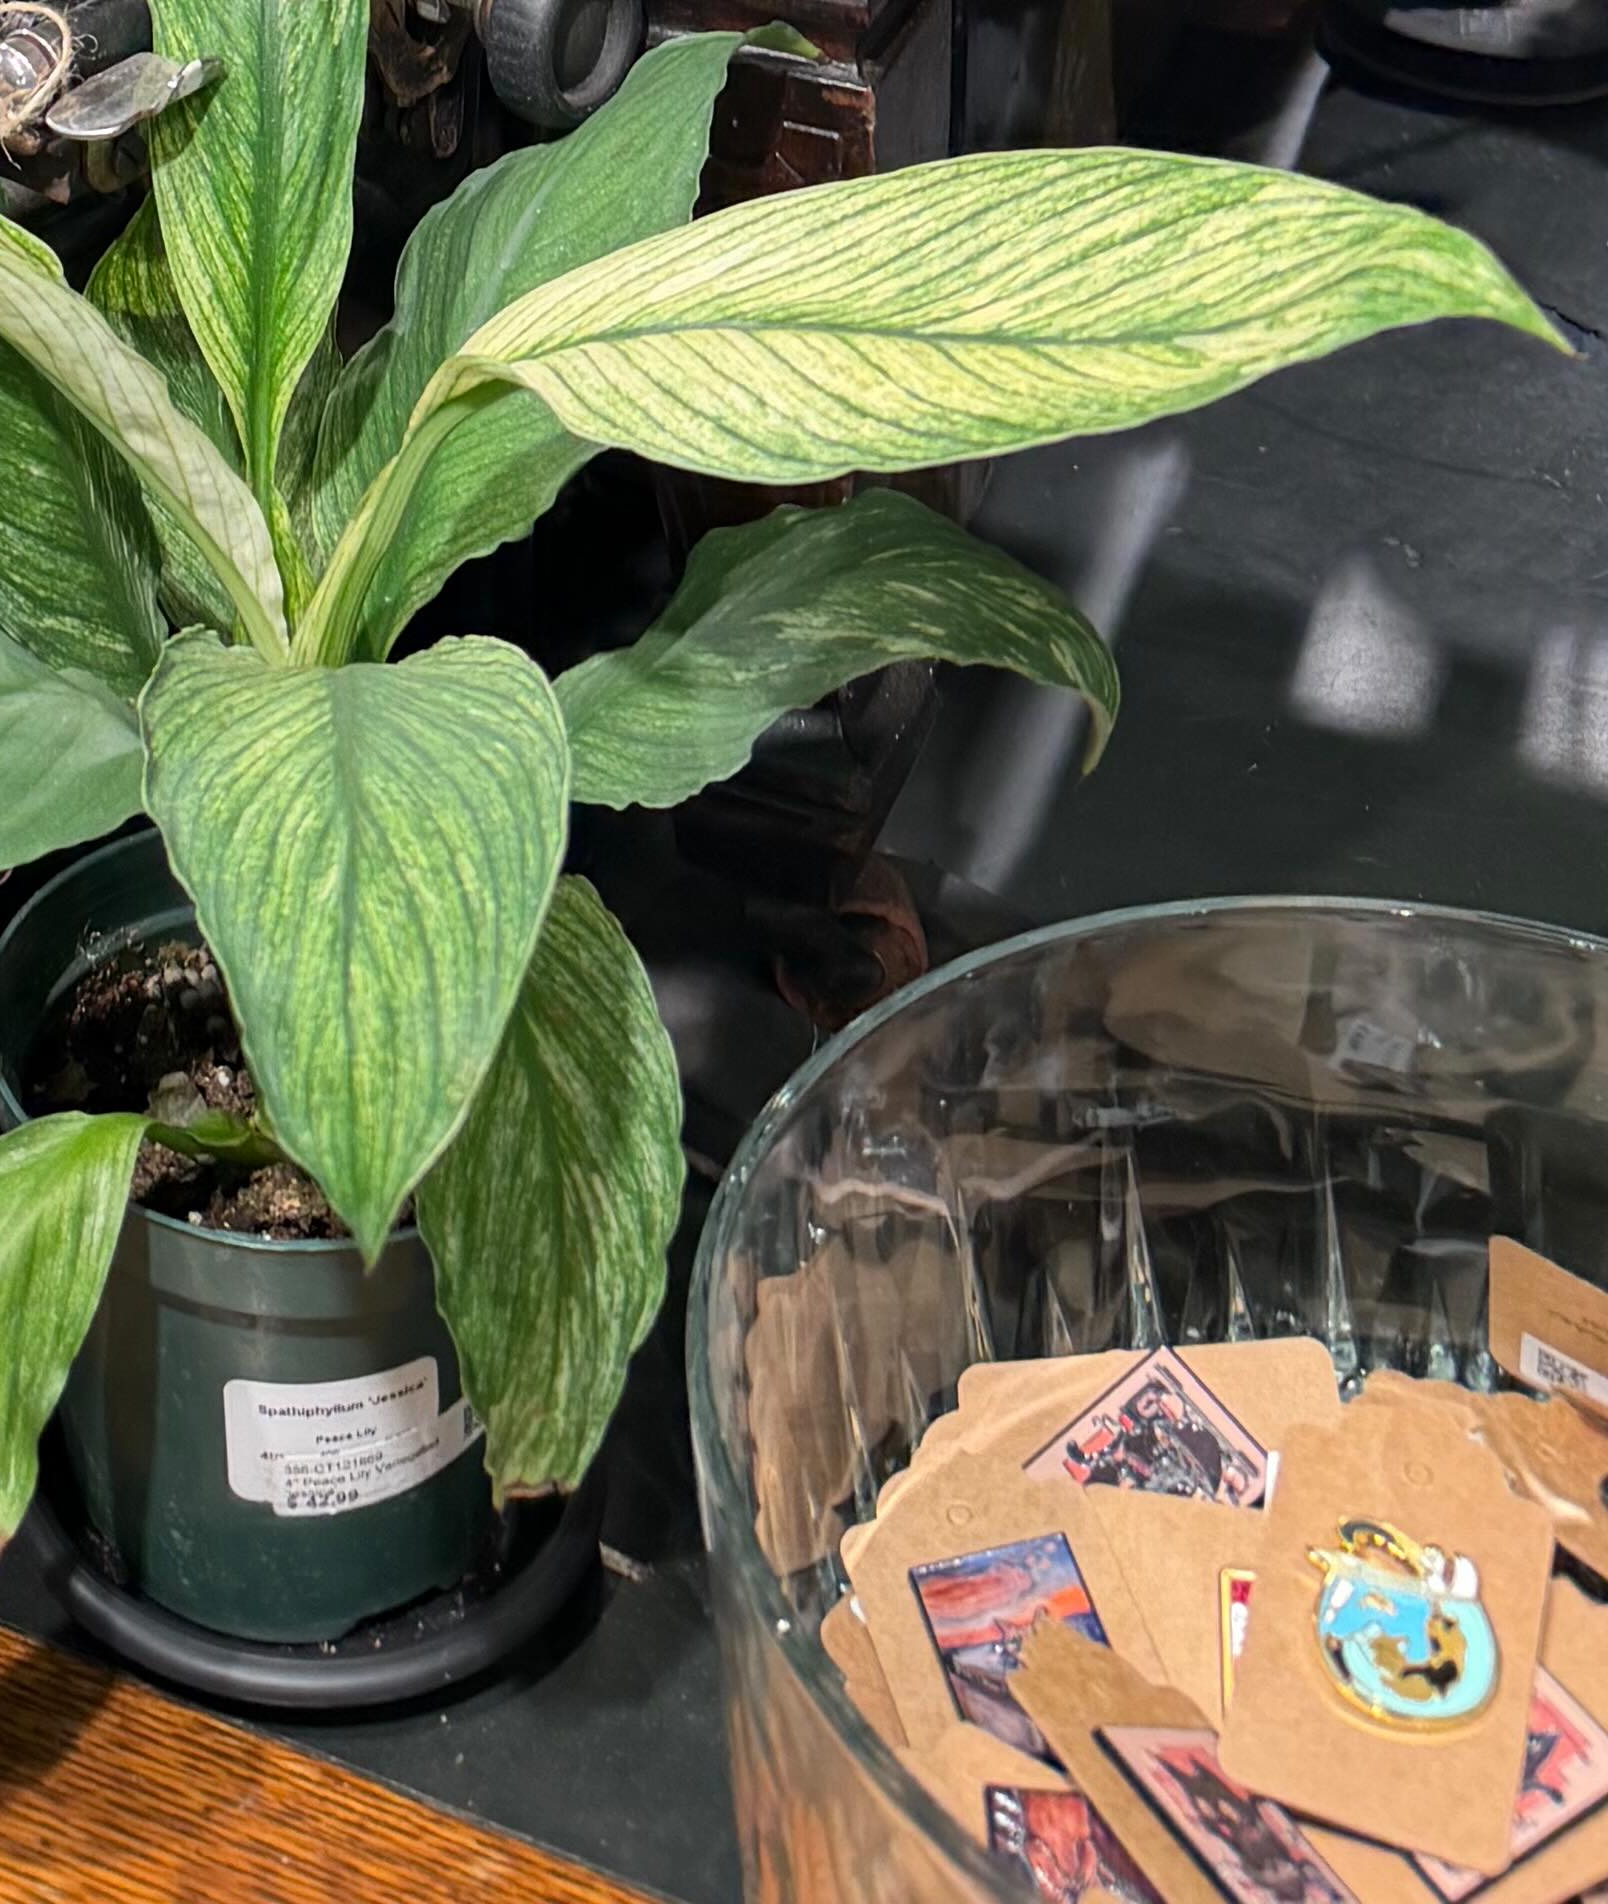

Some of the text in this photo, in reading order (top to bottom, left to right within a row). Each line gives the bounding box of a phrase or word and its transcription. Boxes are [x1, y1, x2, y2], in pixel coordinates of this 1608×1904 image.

[258, 1400, 364, 1420] Spathiphyllum
[315, 1432, 353, 1445] Peace
[356, 1424, 377, 1440] Lily
[302, 1475, 346, 1488] Peace
[349, 1469, 371, 1483] Lily
